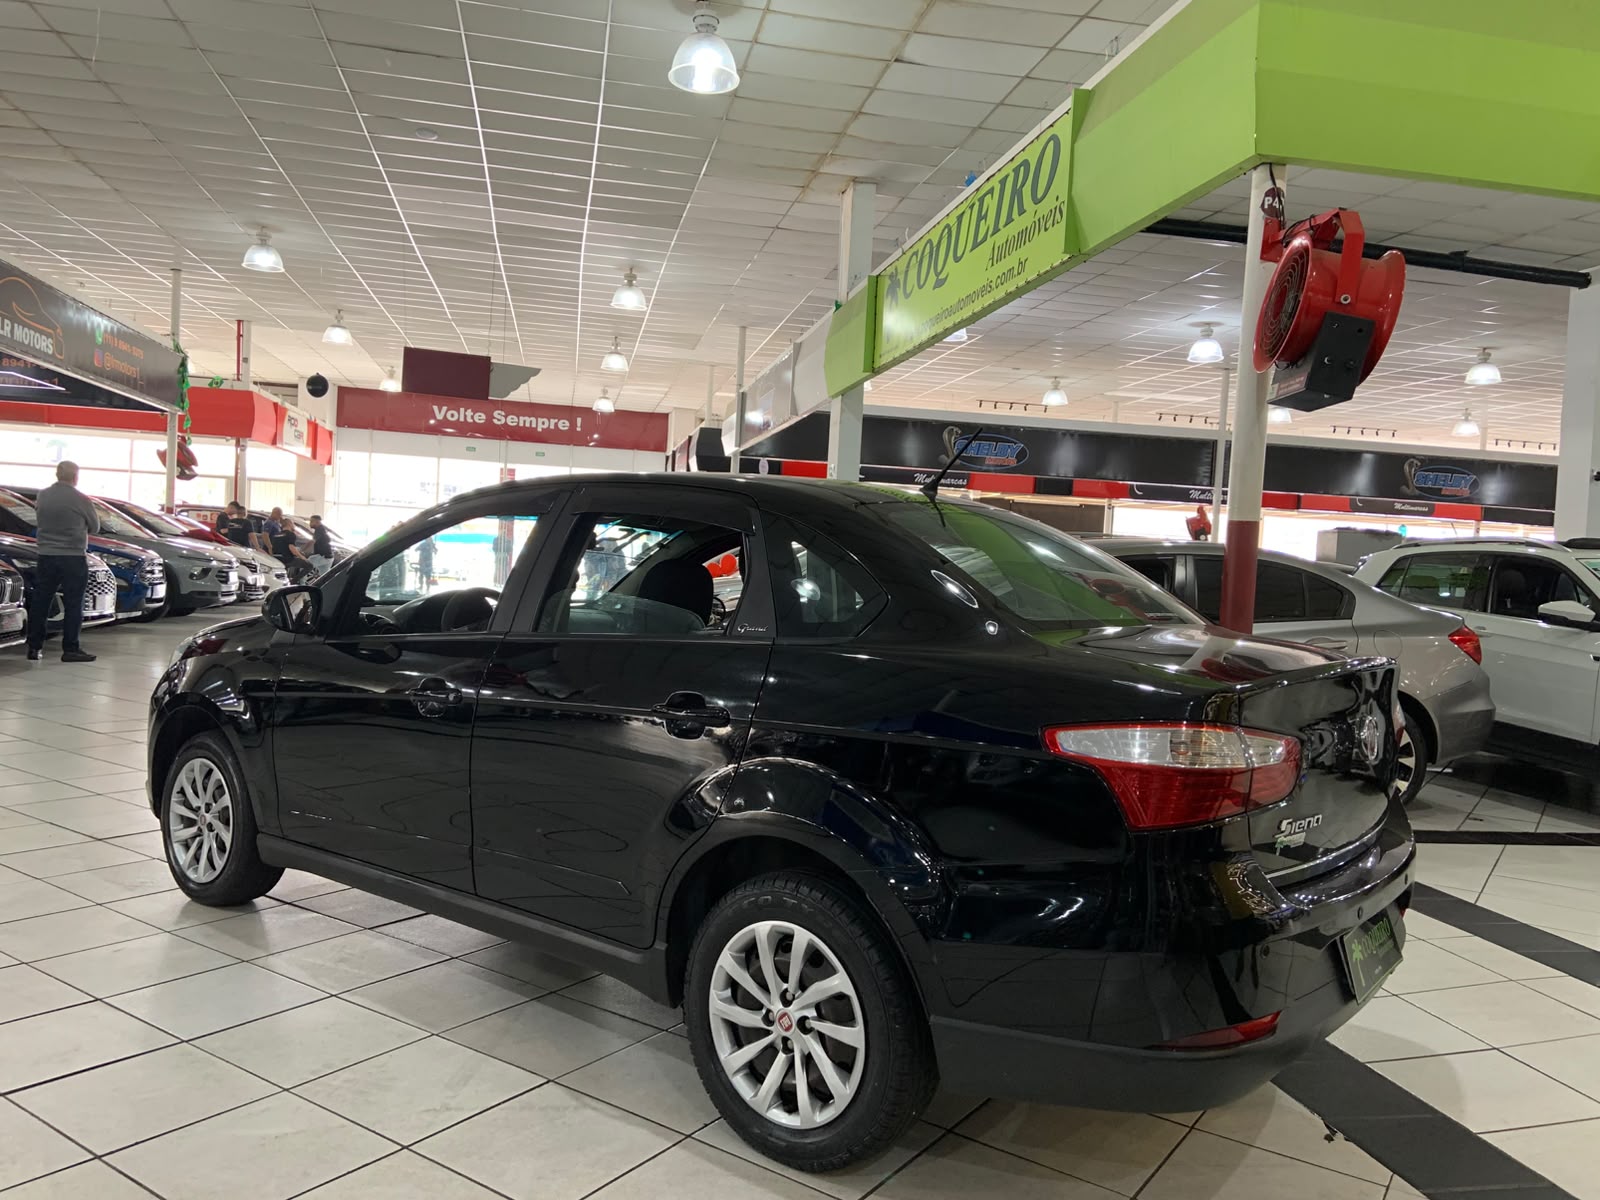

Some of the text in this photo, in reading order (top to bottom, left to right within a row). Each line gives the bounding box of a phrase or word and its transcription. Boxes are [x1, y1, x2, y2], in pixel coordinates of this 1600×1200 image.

[903, 134, 1061, 299] COQUEIRO
[985, 195, 1065, 271] Automóveis
[14, 322, 54, 355] MOTORS
[432, 405, 582, 432] Volte Sempre !
[954, 440, 1024, 459] SHELBY
[1274, 814, 1322, 838] Siena
